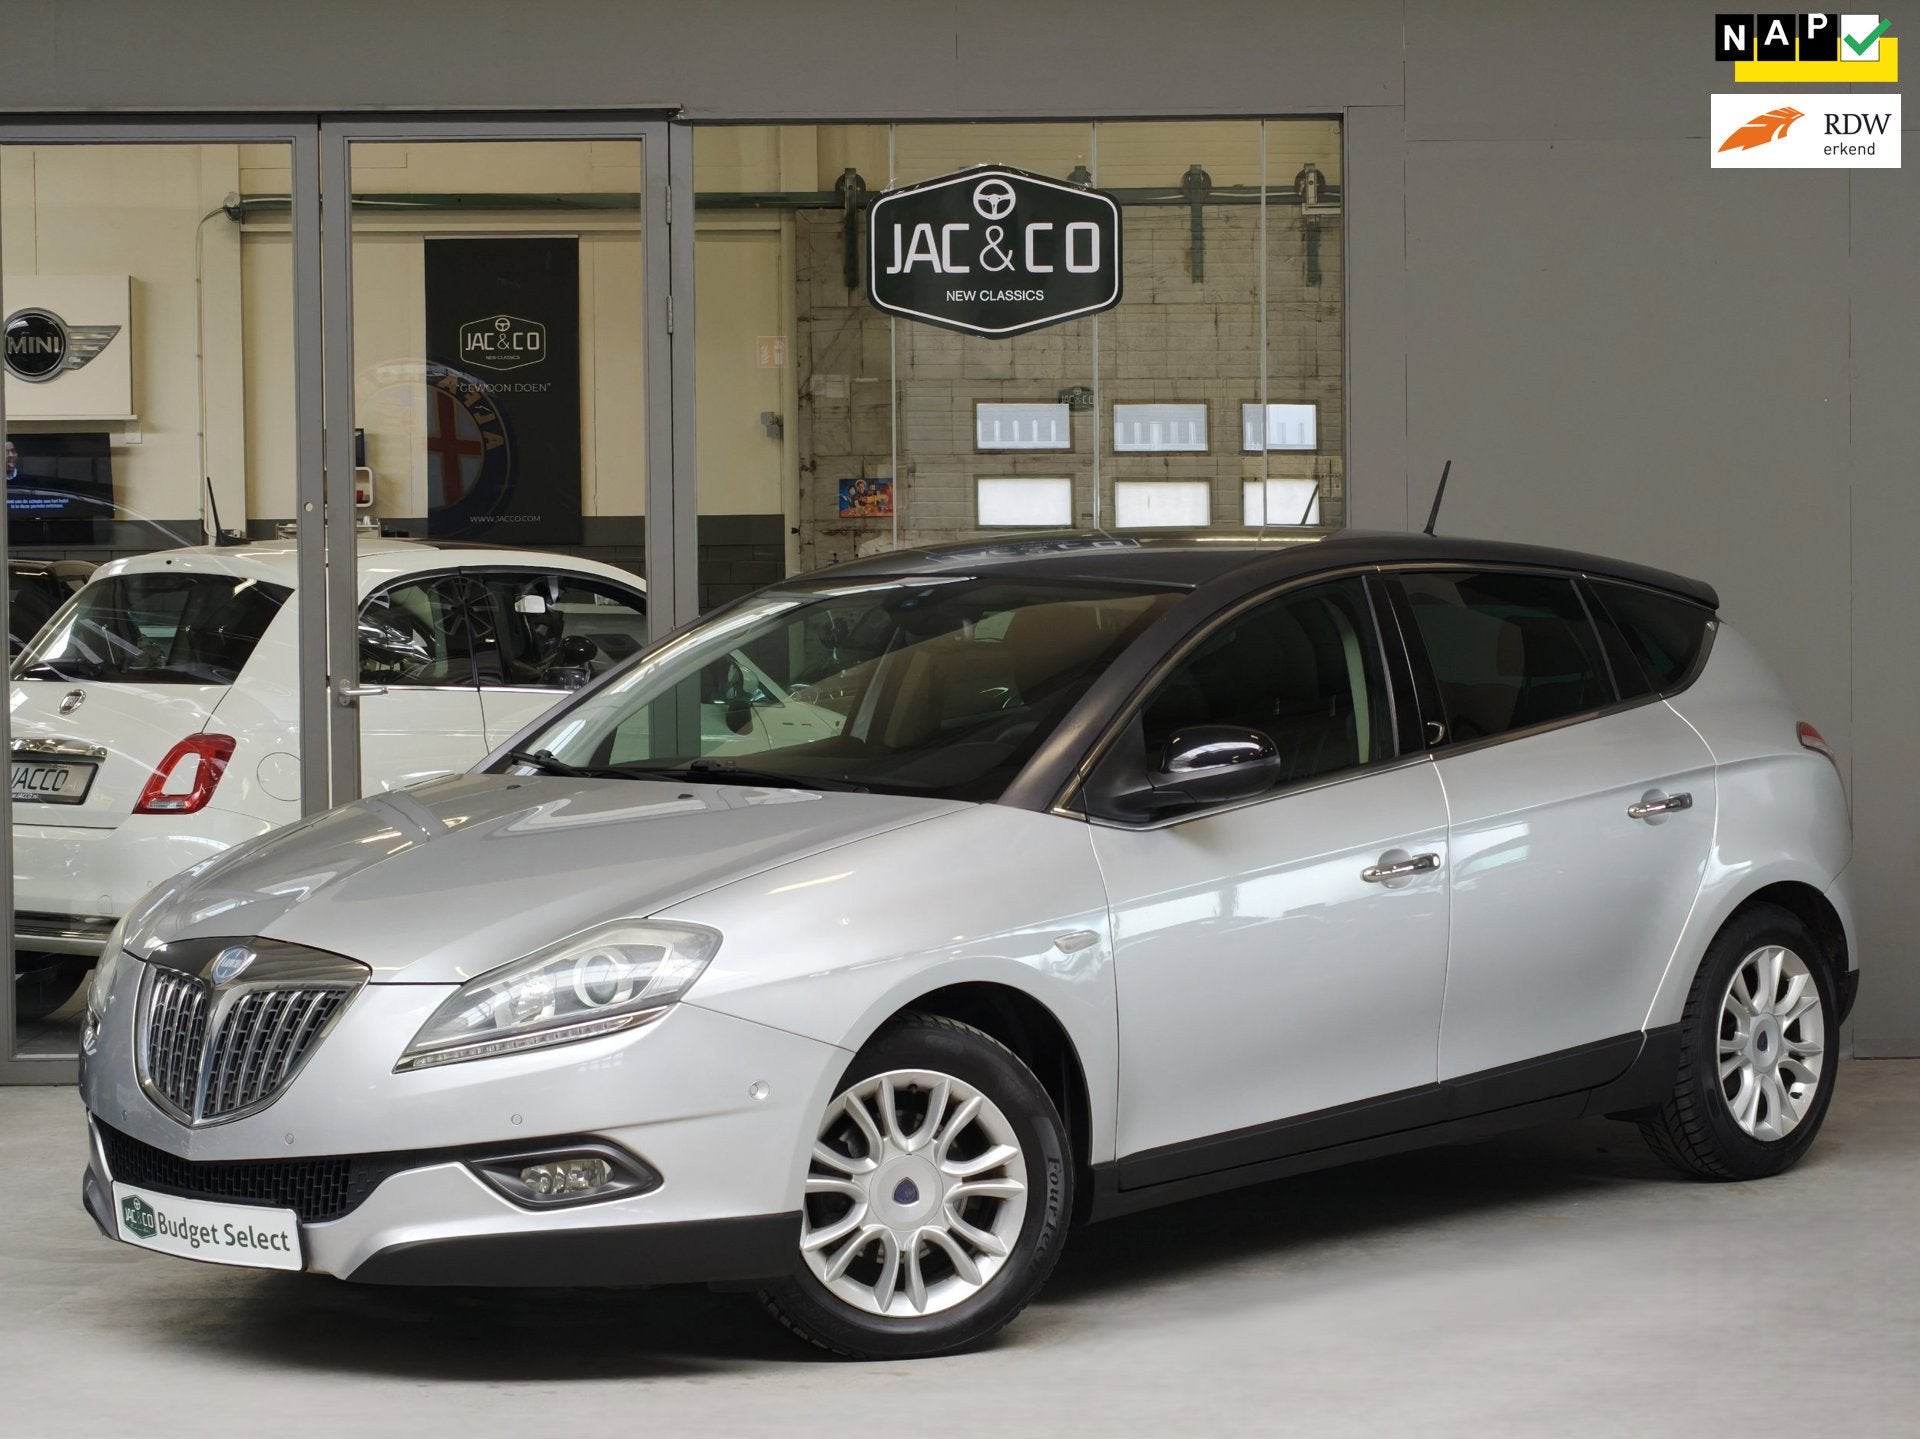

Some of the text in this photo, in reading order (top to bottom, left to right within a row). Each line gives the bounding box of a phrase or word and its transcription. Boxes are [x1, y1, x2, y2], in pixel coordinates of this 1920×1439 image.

[886, 222, 970, 274] JAC
[1025, 222, 1100, 274] CO
[946, 290, 1045, 302] NEW CLASSICS
[7, 336, 59, 354] MINI
[465, 332, 495, 351] JAC
[157, 1211, 291, 1252] Budget Select
